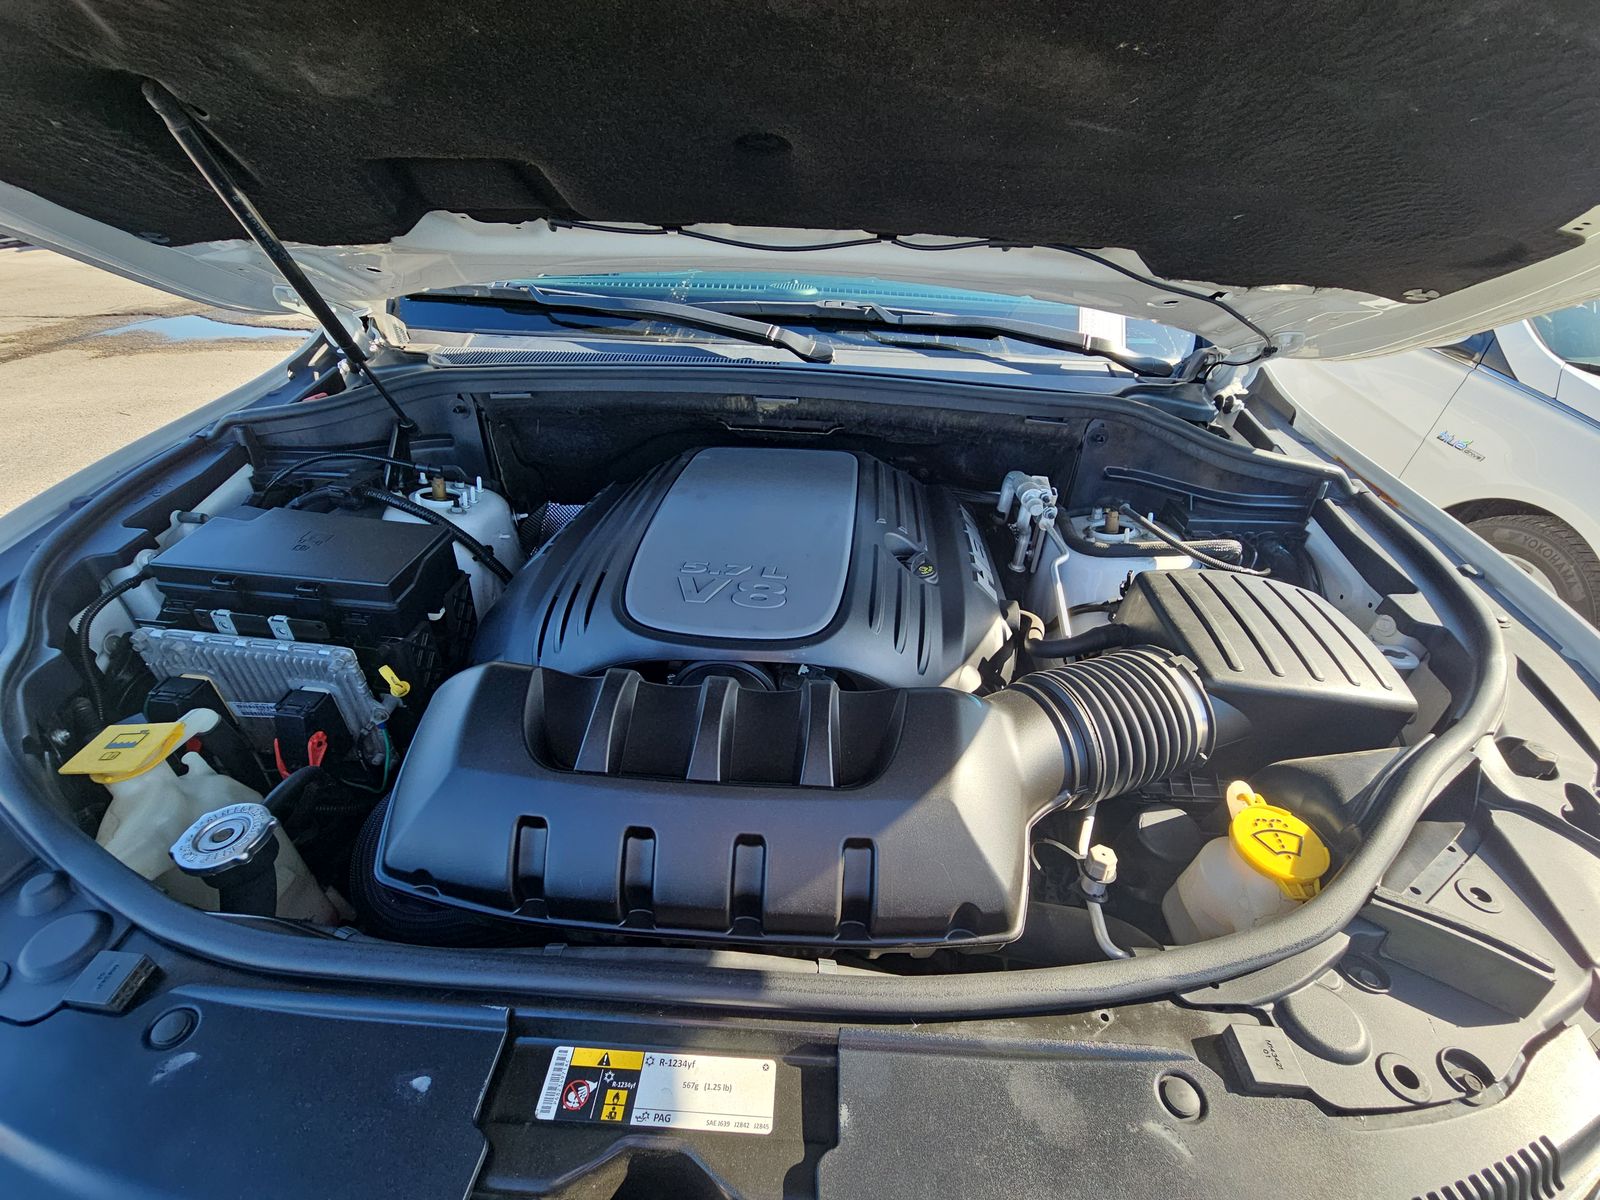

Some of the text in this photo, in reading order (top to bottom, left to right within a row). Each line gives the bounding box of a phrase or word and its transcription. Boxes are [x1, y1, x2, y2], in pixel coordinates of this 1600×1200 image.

[1522, 535, 1577, 588] YOKOHAMA
[680, 561, 788, 580] 5.7 L
[677, 576, 787, 609] V8
[659, 1058, 697, 1070] R-1234yf
[611, 1081, 637, 1090] R-1234yf
[682, 1081, 733, 1094] 567g (1.25 lb)
[653, 1113, 672, 1123] PAG
[706, 1119, 718, 1127] SAE
[733, 1121, 750, 1129] J2842
[753, 1123, 770, 1131] J2845
